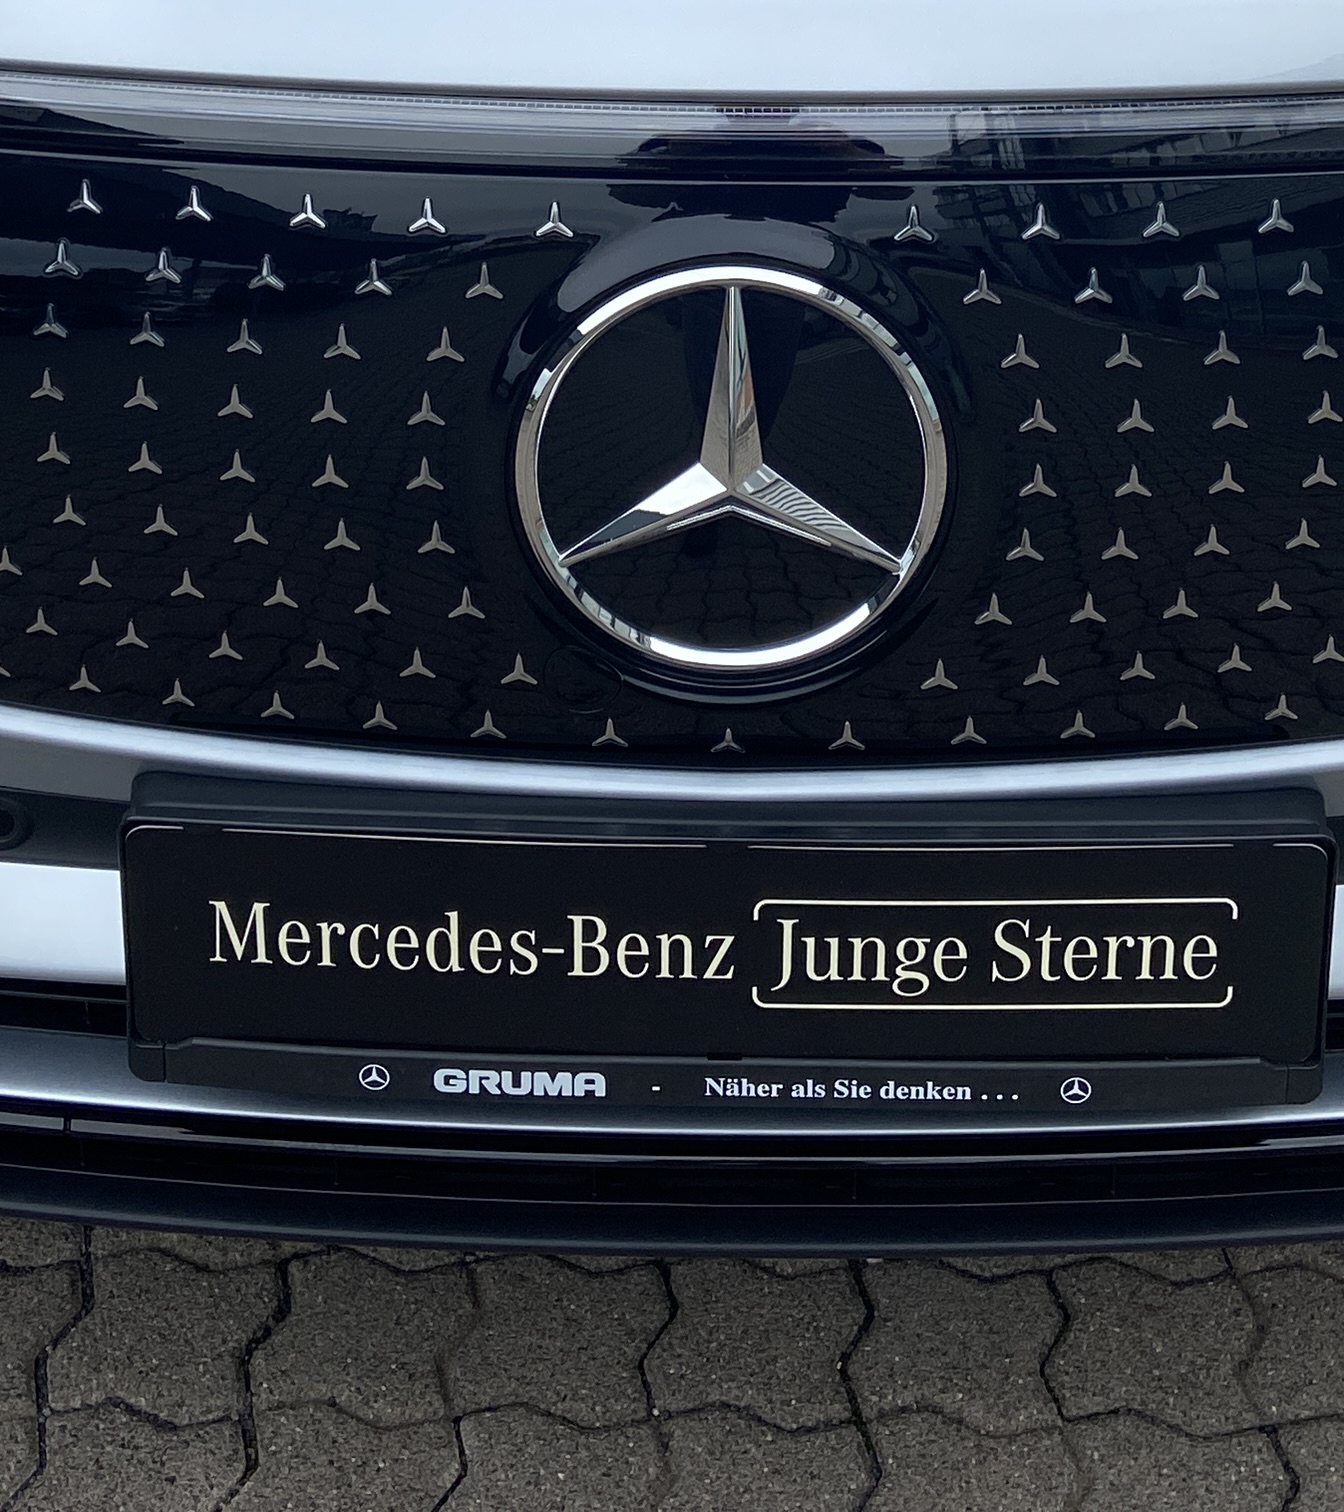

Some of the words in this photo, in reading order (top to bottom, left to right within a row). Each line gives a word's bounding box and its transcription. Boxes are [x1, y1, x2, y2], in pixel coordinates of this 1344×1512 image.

[208, 899, 736, 980] Mercedes-Benz
[770, 918, 968, 997] Junge
[991, 918, 1219, 983] Sterne
[433, 1068, 607, 1097] GRUMA
[704, 1076, 784, 1098] Näher
[791, 1079, 826, 1099] als
[833, 1079, 872, 1100] Sie
[879, 1080, 972, 1101] denken
